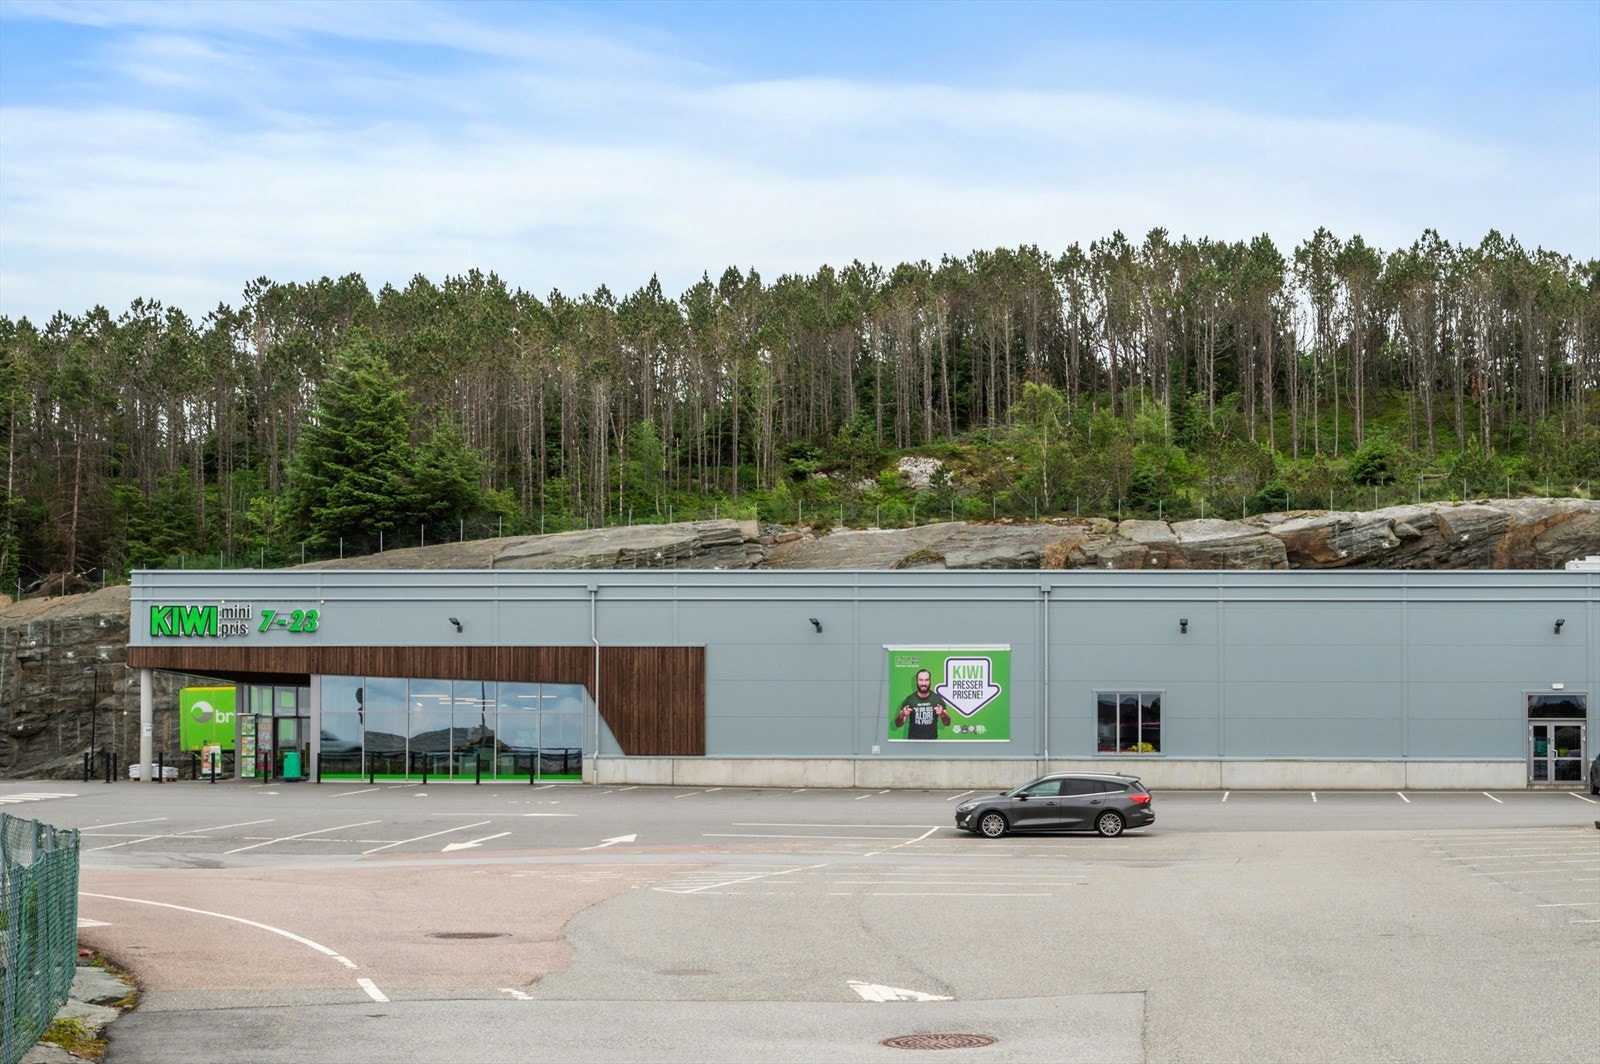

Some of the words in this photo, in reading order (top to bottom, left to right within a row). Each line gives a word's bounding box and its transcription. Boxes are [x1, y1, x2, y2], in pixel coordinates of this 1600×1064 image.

[221, 604, 252, 619] mini
[150, 605, 218, 637] KIWI
[221, 621, 249, 638] pris
[952, 665, 983, 679] KIWI
[952, 680, 983, 690] PRESSER
[952, 690, 983, 699] PRISENE!
